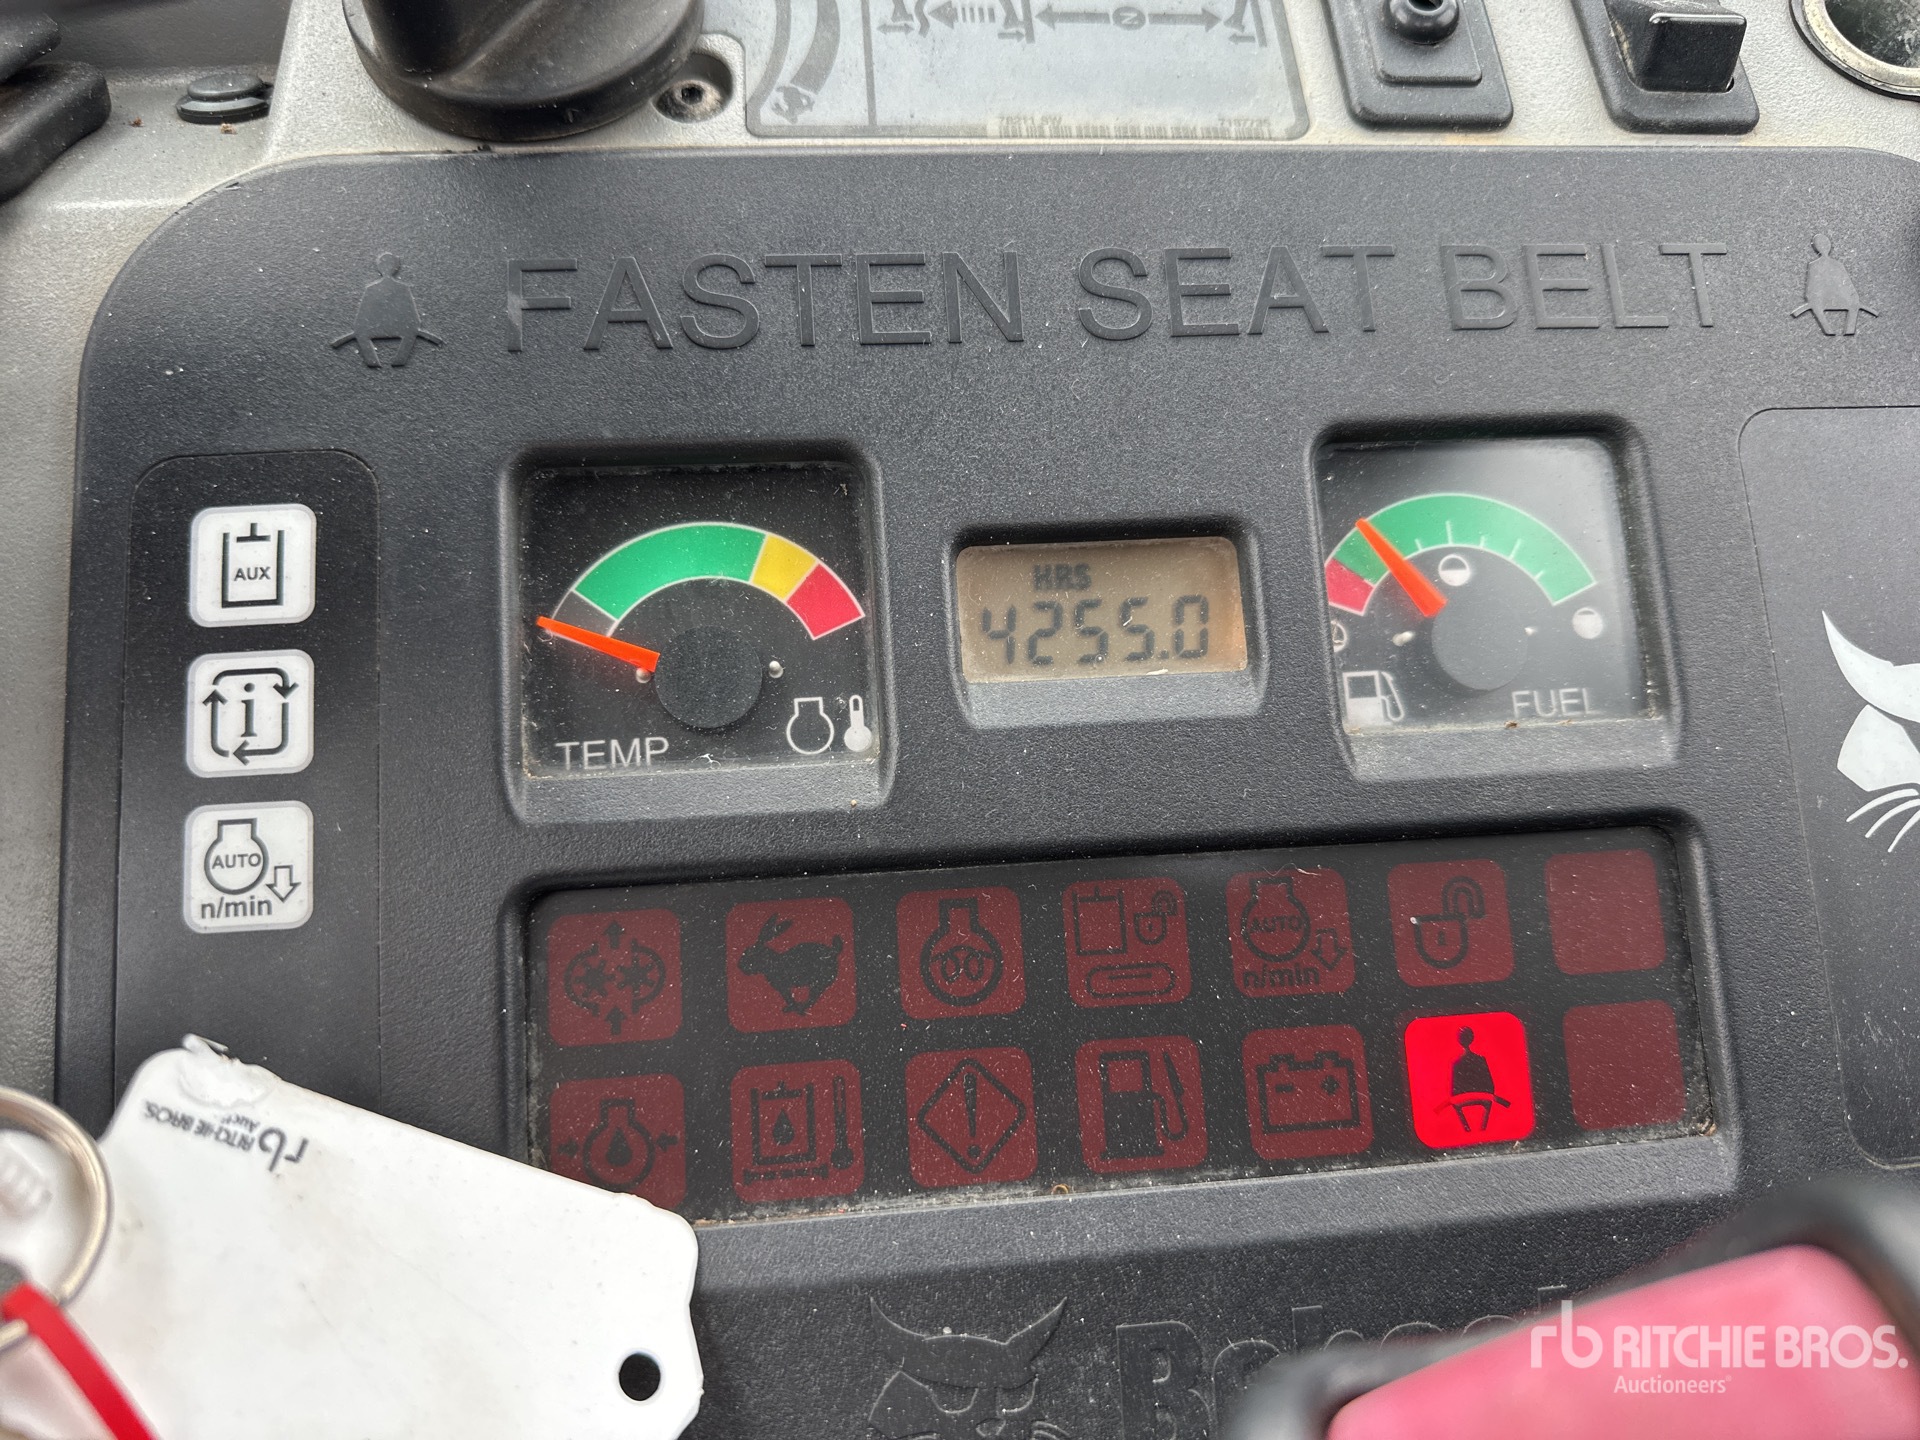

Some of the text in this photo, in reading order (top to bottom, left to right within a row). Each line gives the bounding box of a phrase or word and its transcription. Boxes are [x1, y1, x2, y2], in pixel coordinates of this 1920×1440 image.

[506, 242, 1728, 353] FASTEN SEAT BELT
[233, 565, 272, 583] AUX
[1033, 562, 1092, 591] HRS
[981, 593, 1210, 667] 4255.0
[1511, 687, 1599, 719] FUEL
[555, 736, 670, 771] TEMP
[211, 852, 262, 870] AUTO
[200, 898, 273, 920] n/min
[1249, 914, 1304, 933] AUTO
[1242, 961, 1320, 989] n/min
[194, 1118, 256, 1152] RITCHIE
